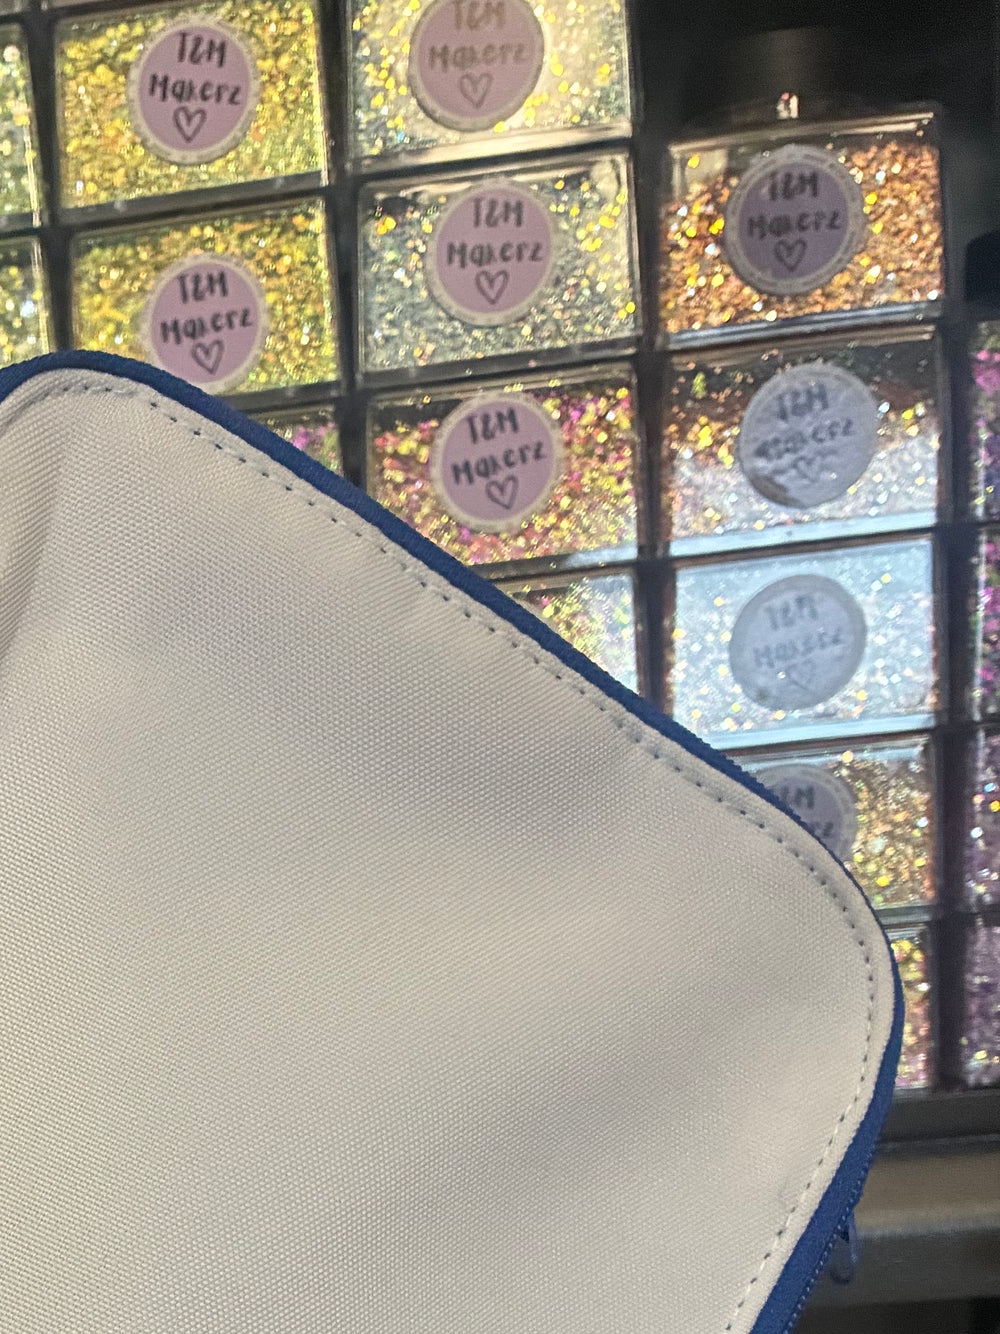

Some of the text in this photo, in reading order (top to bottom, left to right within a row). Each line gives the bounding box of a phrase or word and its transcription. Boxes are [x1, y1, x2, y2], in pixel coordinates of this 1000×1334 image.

[177, 32, 226, 68] T&M
[149, 73, 241, 105] Makerz
[473, 198, 523, 228] T&M
[447, 242, 543, 269] Makerz
[178, 271, 228, 304] T&M
[160, 308, 251, 345] Makerz
[467, 407, 518, 445] T&M
[452, 441, 546, 486] Makerz
